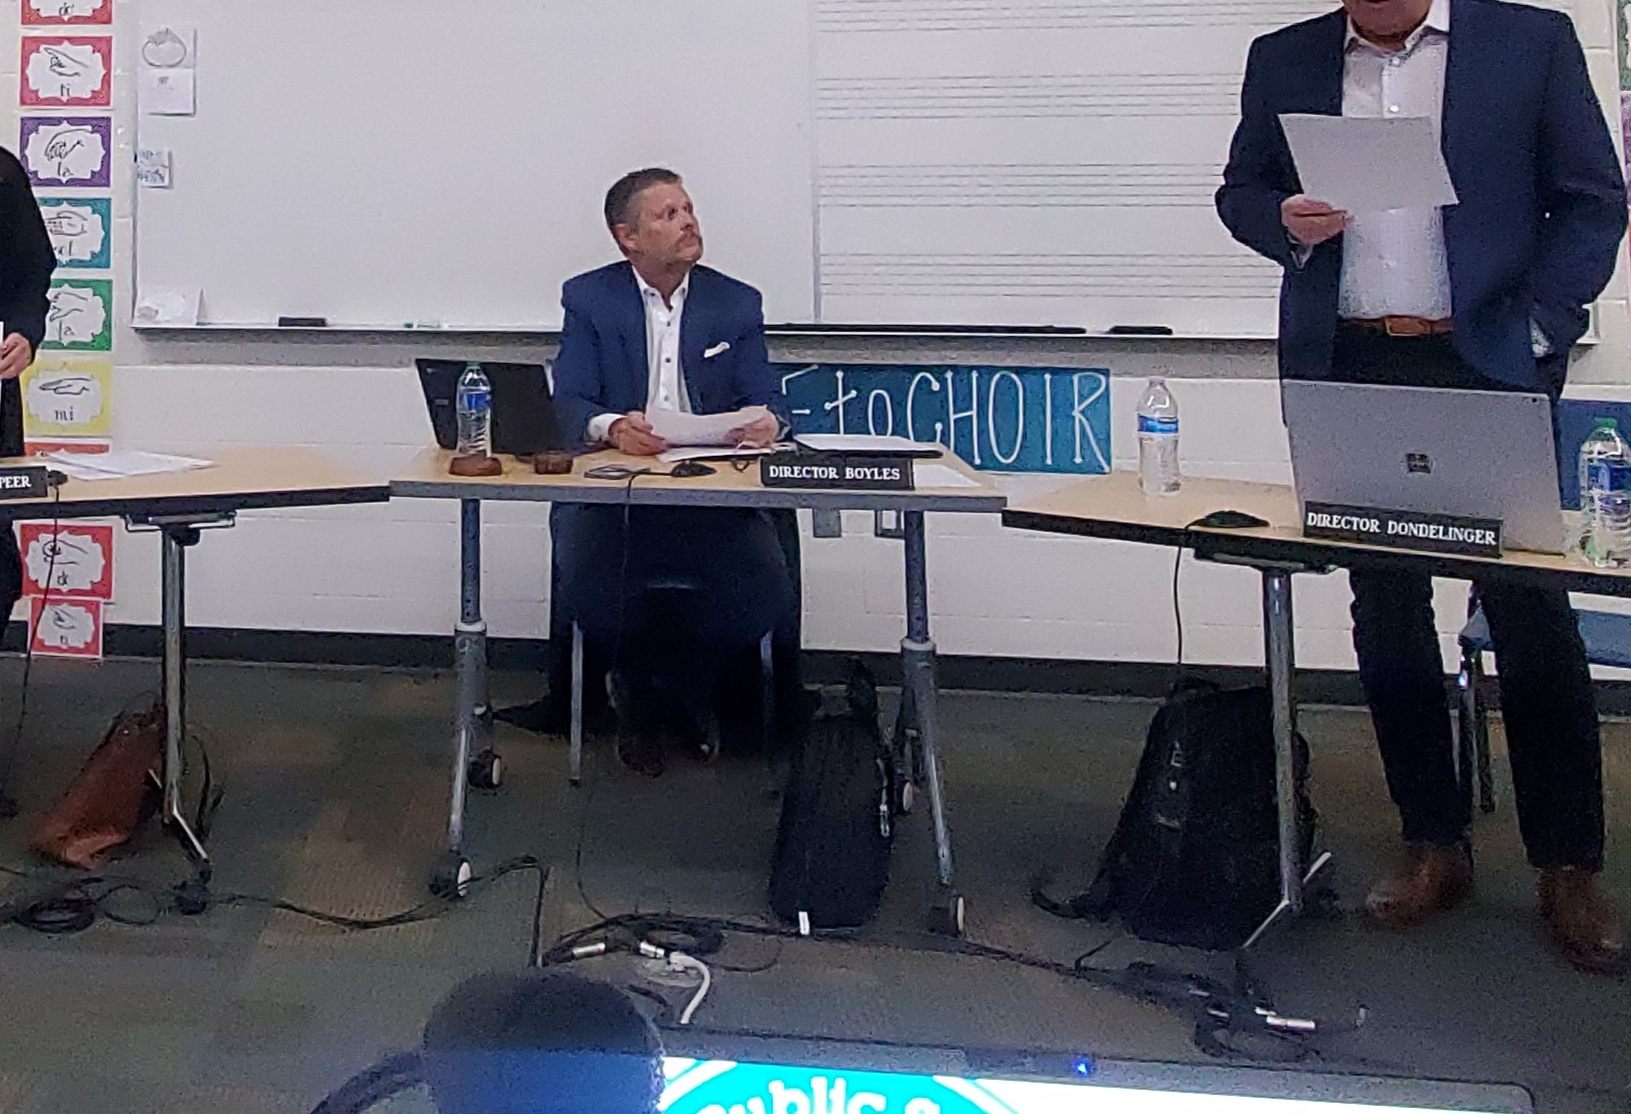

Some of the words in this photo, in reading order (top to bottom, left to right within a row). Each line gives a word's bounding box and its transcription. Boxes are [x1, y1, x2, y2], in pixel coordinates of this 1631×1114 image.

[60, 84, 70, 97] ti
[54, 405, 74, 421] mi
[907, 369, 1112, 473] CHOIR
[769, 465, 840, 480] DIRECTOR
[844, 466, 901, 481] BOYLES
[1306, 511, 1381, 534] DIRECTOR
[1386, 519, 1498, 546] DONDELINGER
